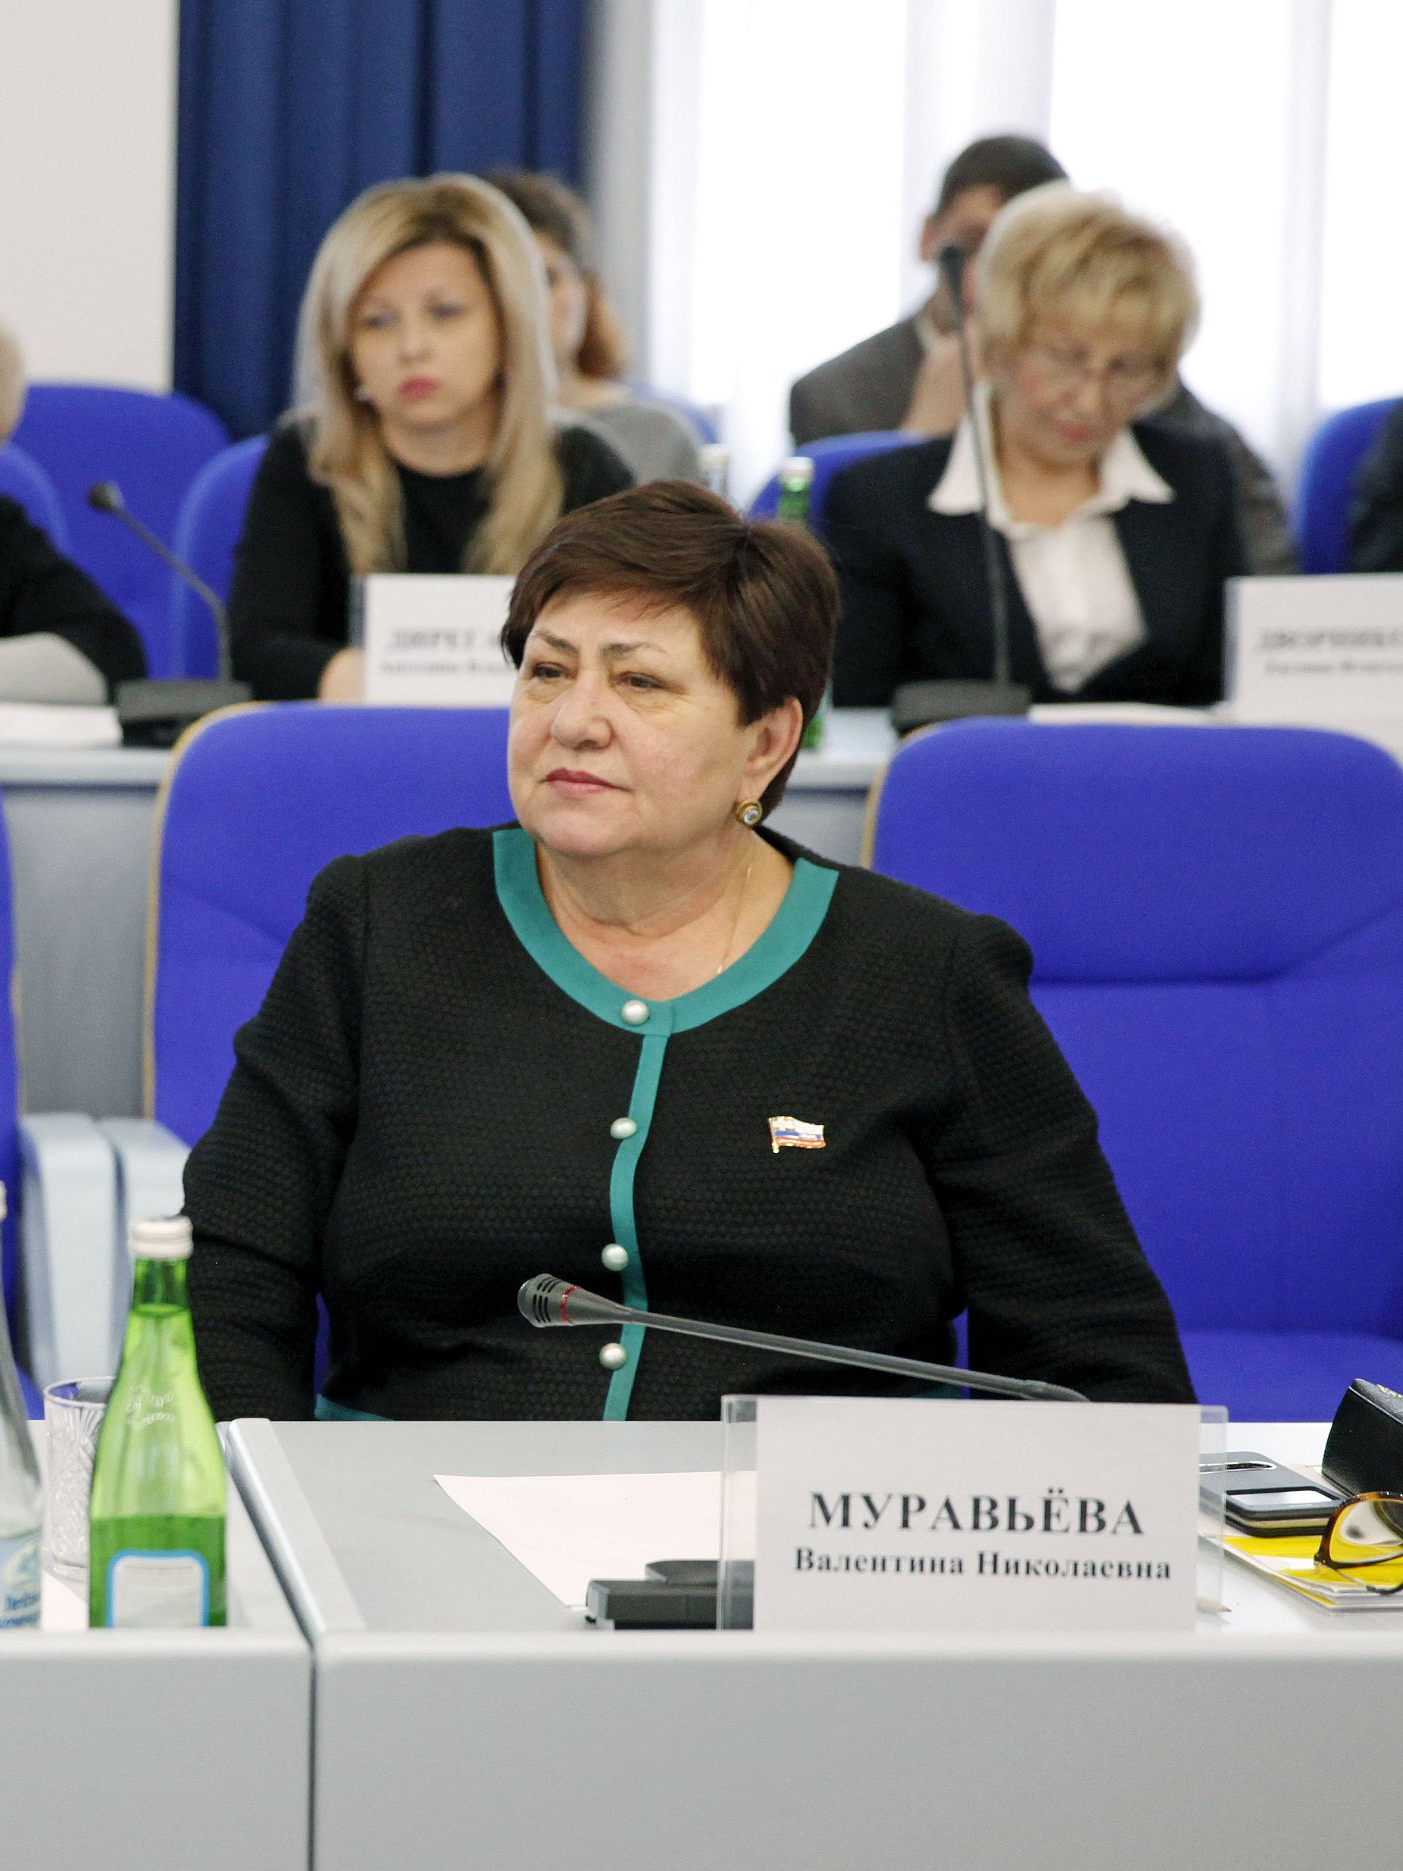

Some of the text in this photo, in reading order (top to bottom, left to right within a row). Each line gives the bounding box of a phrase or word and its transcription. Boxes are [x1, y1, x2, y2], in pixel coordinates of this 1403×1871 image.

[809, 1486, 1145, 1537] МУРАВЬЁВА
[794, 1546, 1172, 1581] Валентина Николаевна
